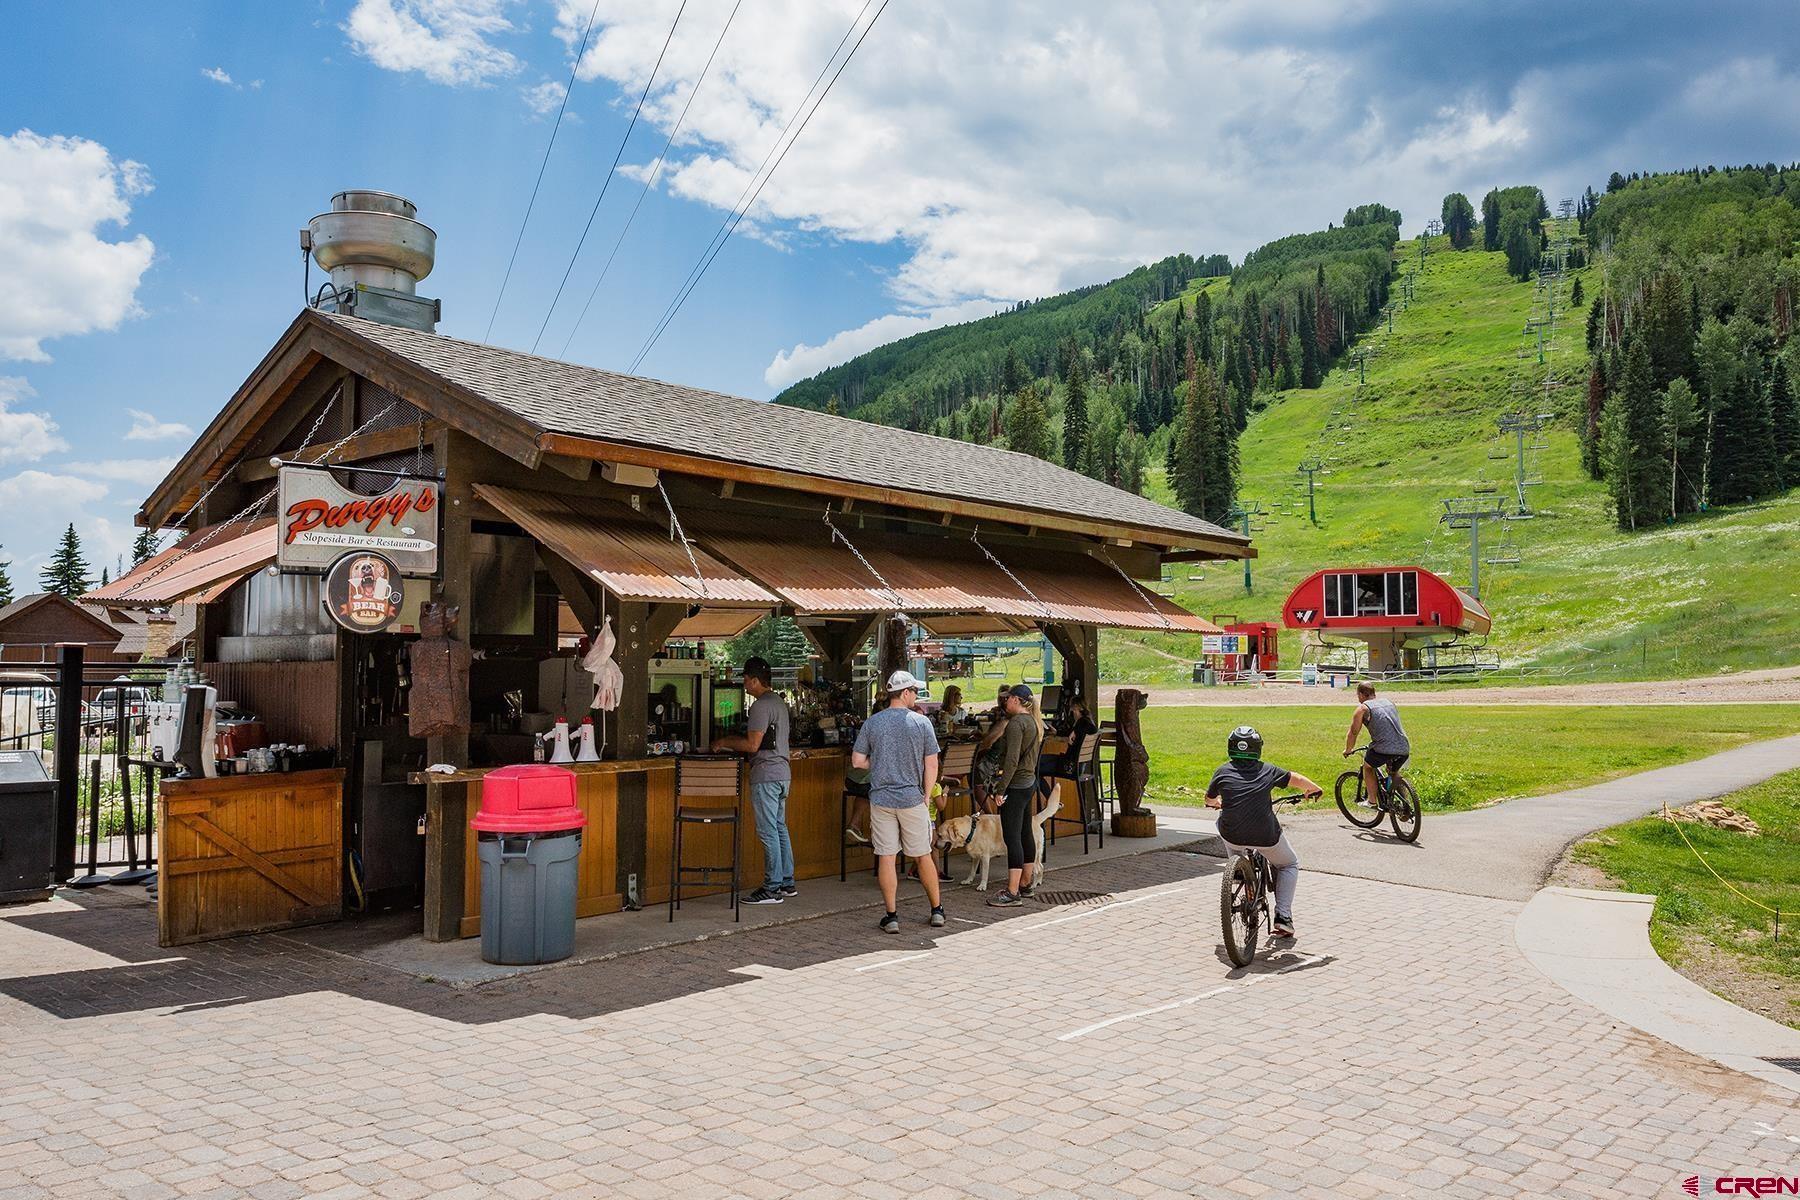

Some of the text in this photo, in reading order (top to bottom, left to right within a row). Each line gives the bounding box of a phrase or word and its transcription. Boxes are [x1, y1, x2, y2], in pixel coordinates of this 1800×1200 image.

[303, 532, 421, 549] Slopeside Bar & Restaurant
[352, 601, 385, 614] BEAR
